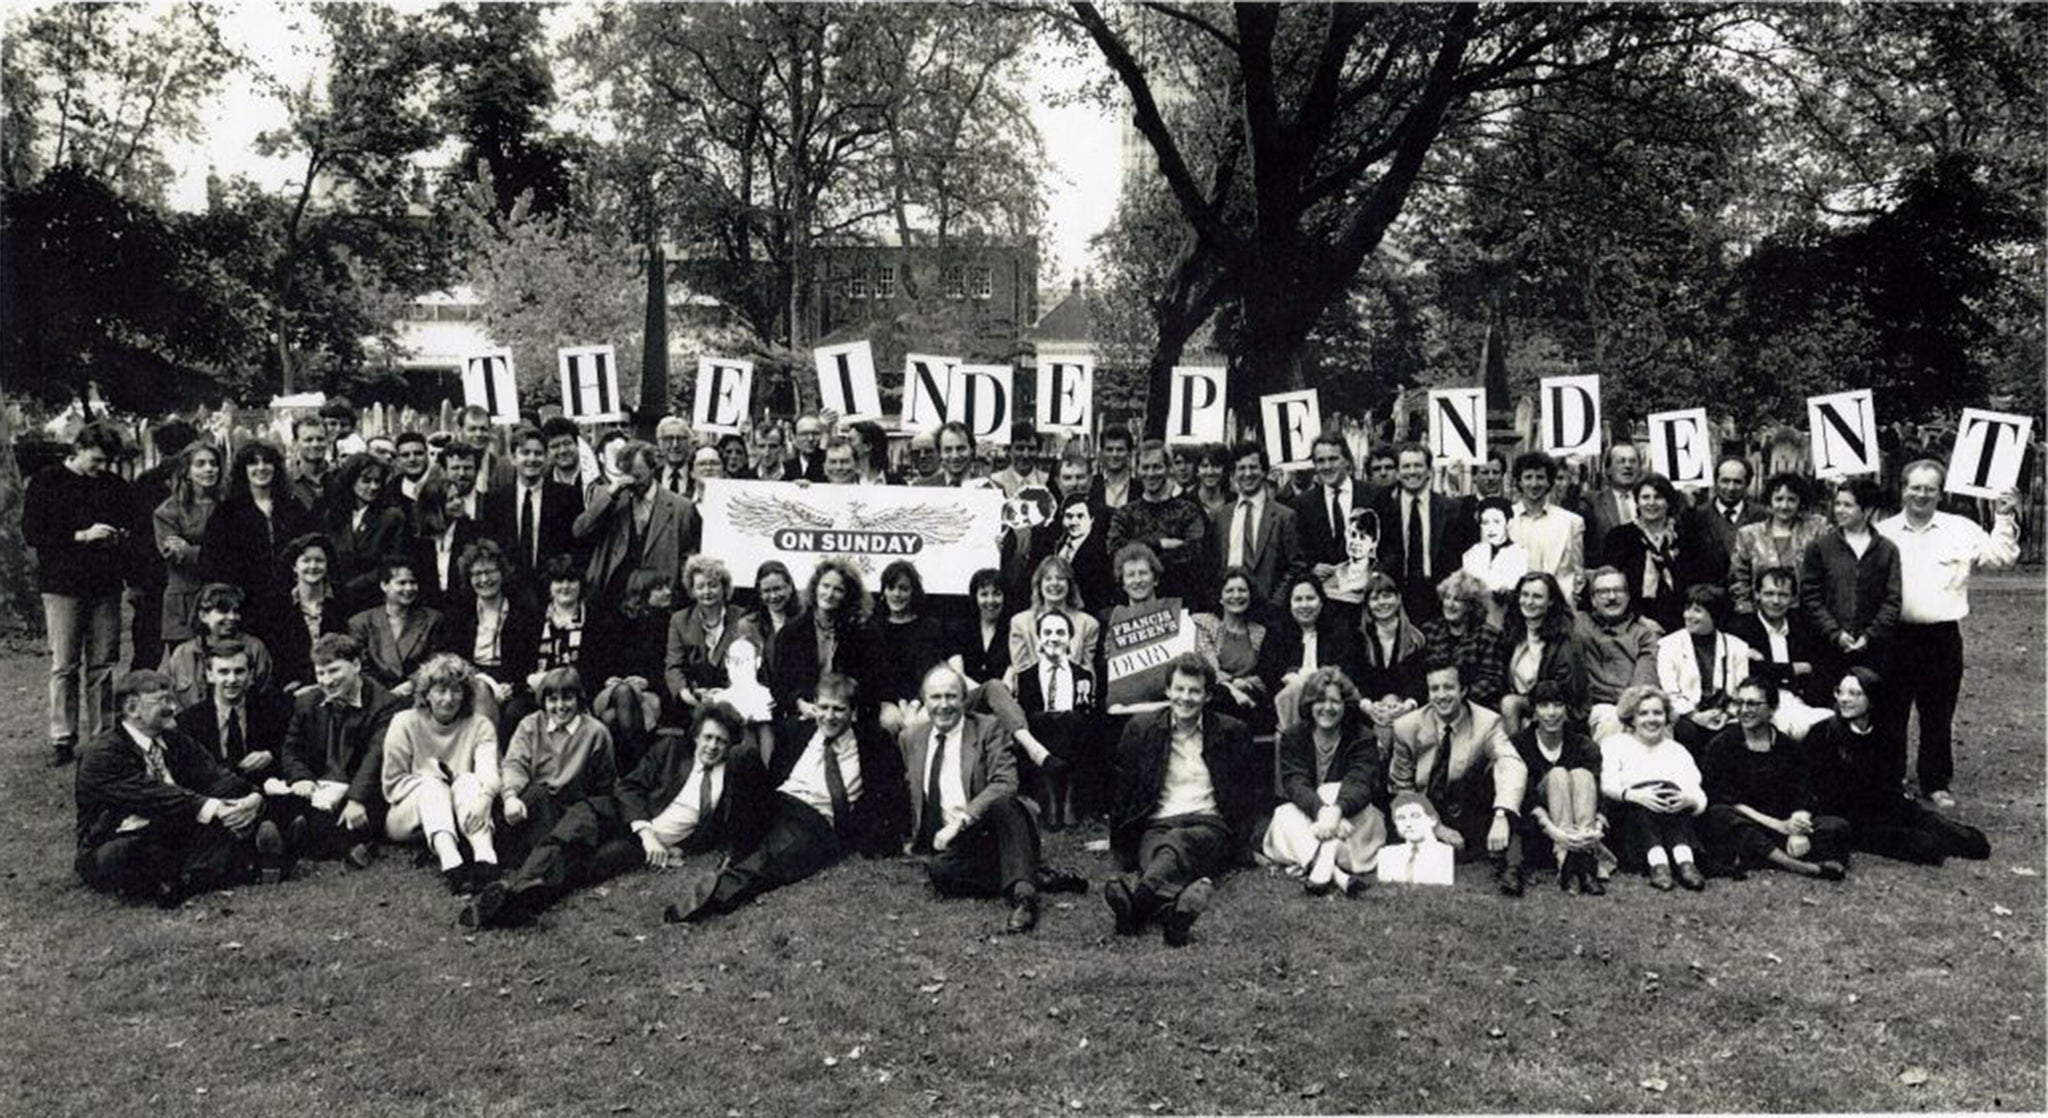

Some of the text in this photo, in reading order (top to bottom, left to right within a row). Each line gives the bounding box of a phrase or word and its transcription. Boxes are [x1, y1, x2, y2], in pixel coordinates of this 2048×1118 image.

[781, 531, 918, 554] ON SUNDAY
[1112, 609, 1172, 636] FRANCIS
[1115, 620, 1178, 647] WHEEN'S
[1112, 643, 1173, 677] DIARY
